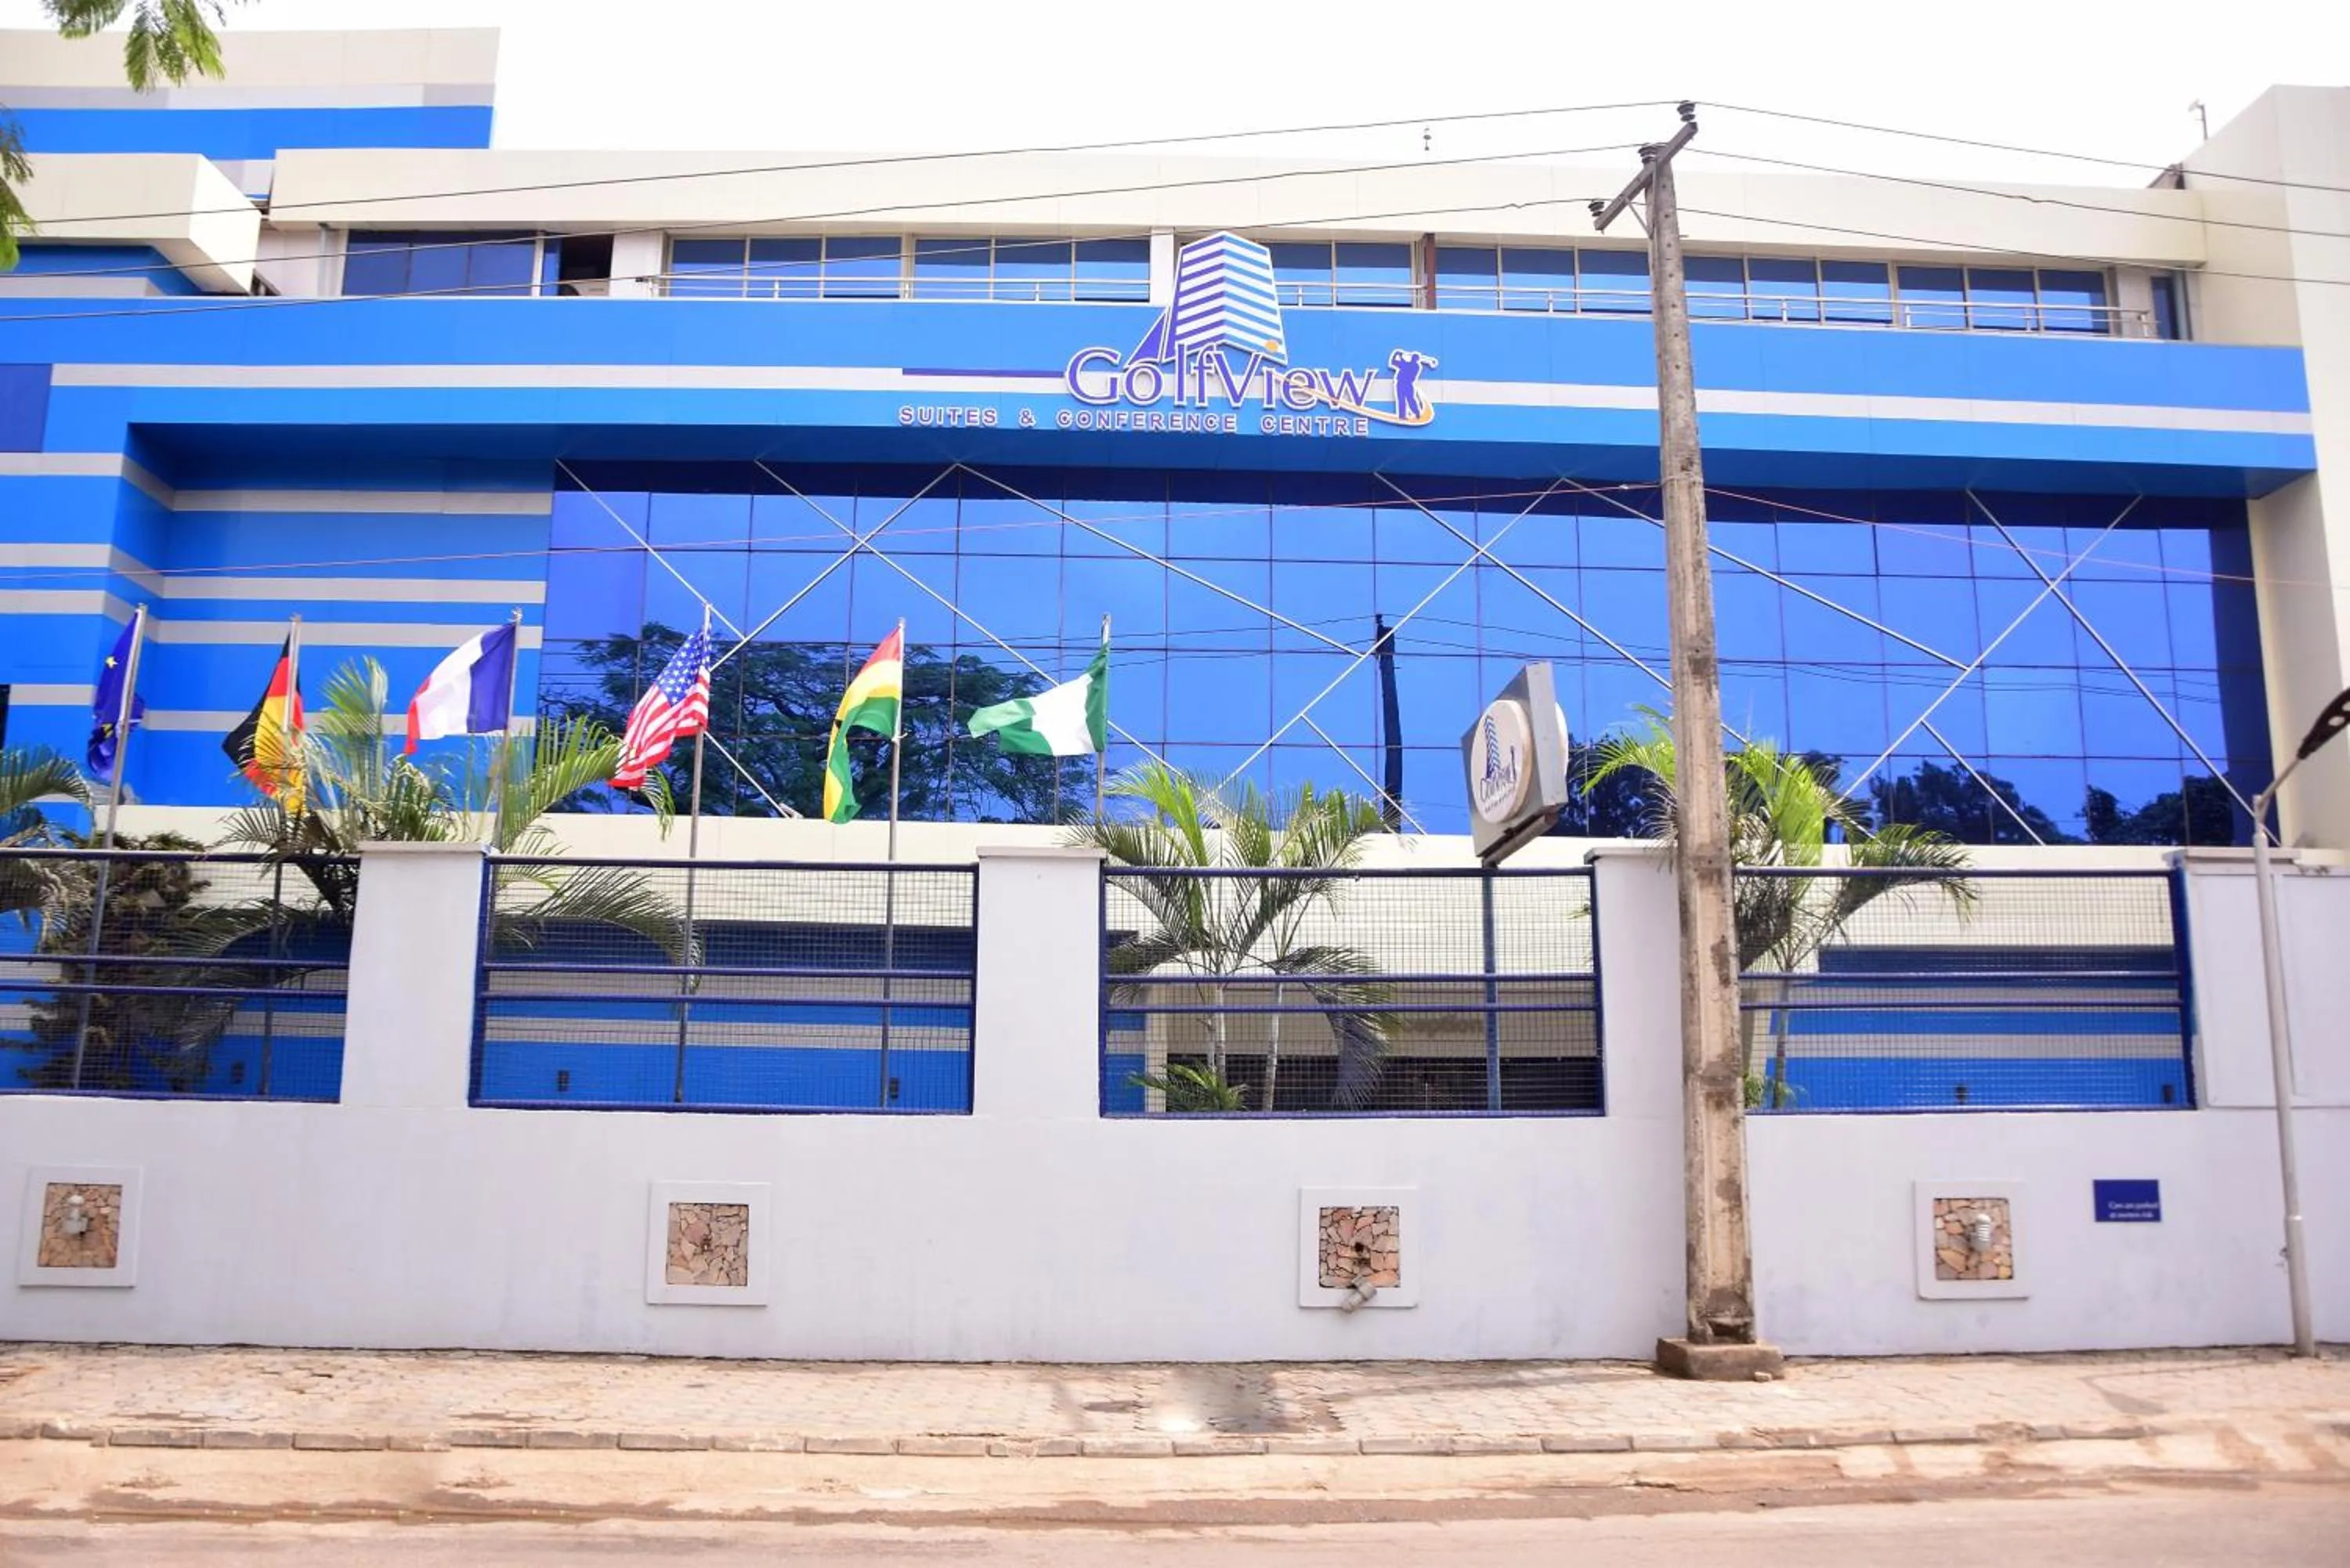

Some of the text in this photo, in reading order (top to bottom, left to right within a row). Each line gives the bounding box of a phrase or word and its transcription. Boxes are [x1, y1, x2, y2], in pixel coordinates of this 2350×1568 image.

[899, 406, 1369, 436] SUITES & CONFERENCE CENTRE
